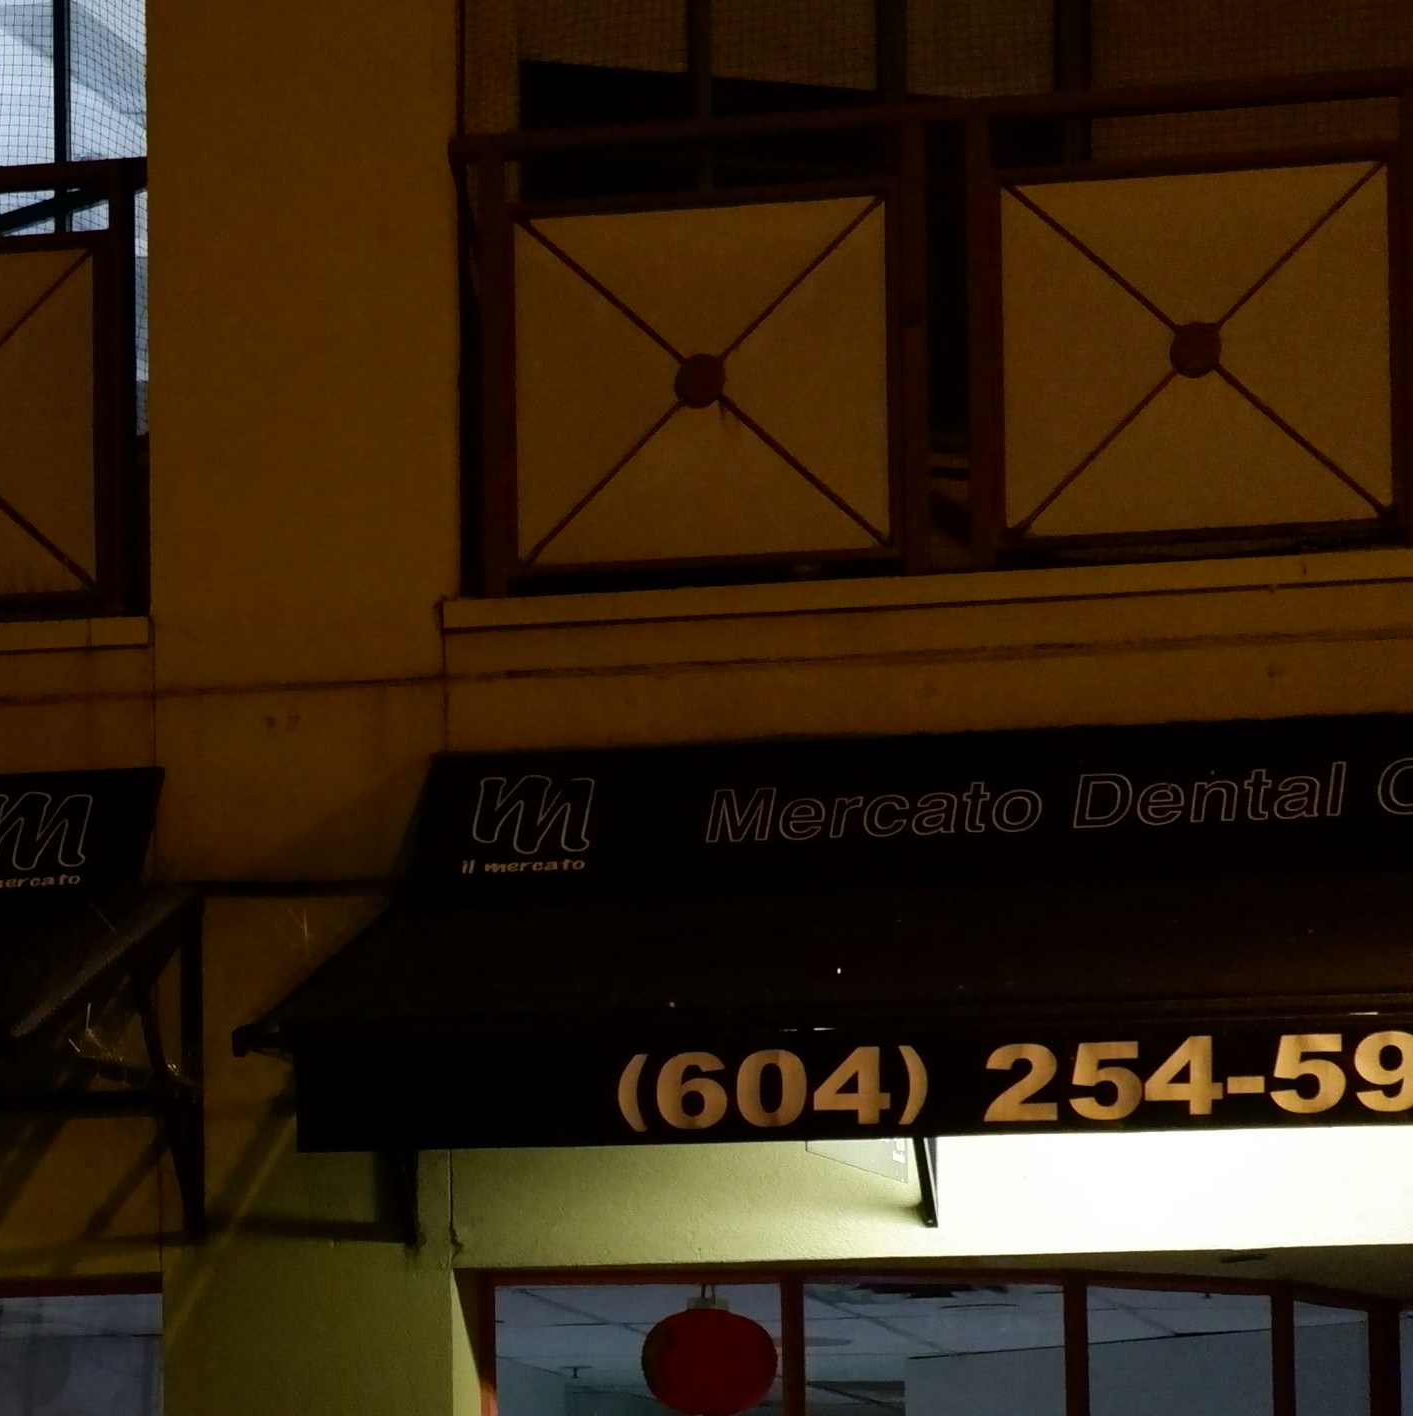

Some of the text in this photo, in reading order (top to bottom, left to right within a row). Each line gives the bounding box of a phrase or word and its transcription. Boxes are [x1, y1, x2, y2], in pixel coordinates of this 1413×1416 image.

[706, 782, 1043, 843] Mercato
[1073, 760, 1345, 830] Dental
[483, 855, 586, 874] mercato
[617, 1044, 929, 1133] (604)
